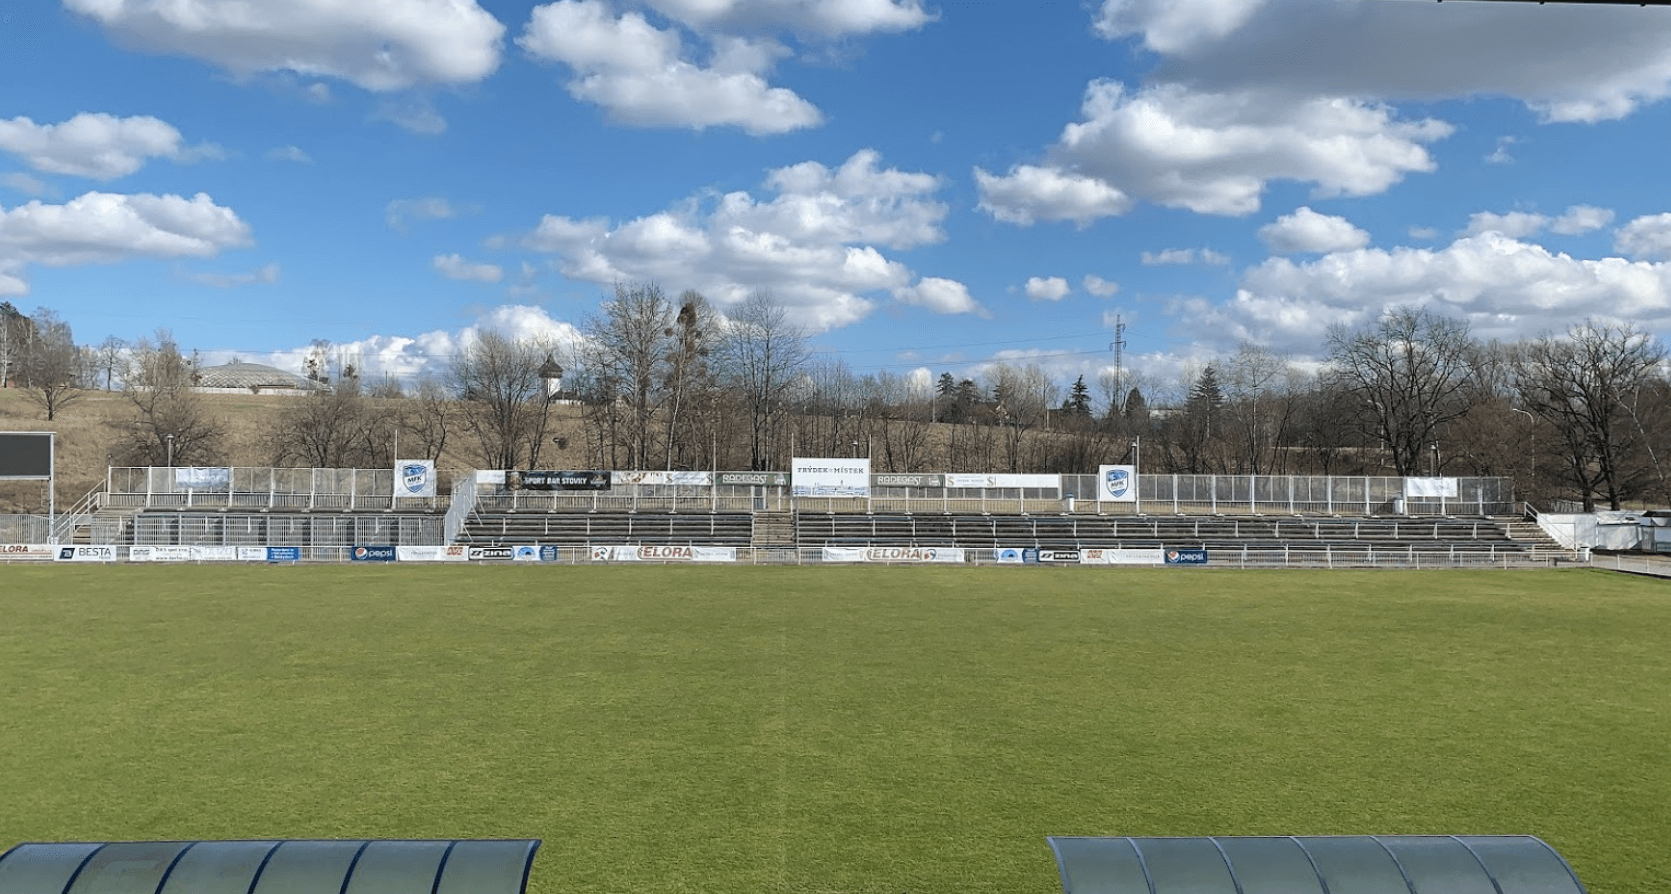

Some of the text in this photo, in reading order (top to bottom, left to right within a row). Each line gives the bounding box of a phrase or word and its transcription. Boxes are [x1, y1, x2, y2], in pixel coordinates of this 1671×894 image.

[525, 477, 545, 485] SPORT
[562, 477, 587, 485] STOVKY
[722, 474, 768, 484] RADEGAST
[878, 476, 923, 487] RADEGAST
[78, 547, 112, 557] BESTA
[368, 549, 393, 559] pepsi
[643, 547, 692, 557] ELORA
[871, 548, 920, 559] ELORA
[1180, 552, 1204, 562] pepsi
